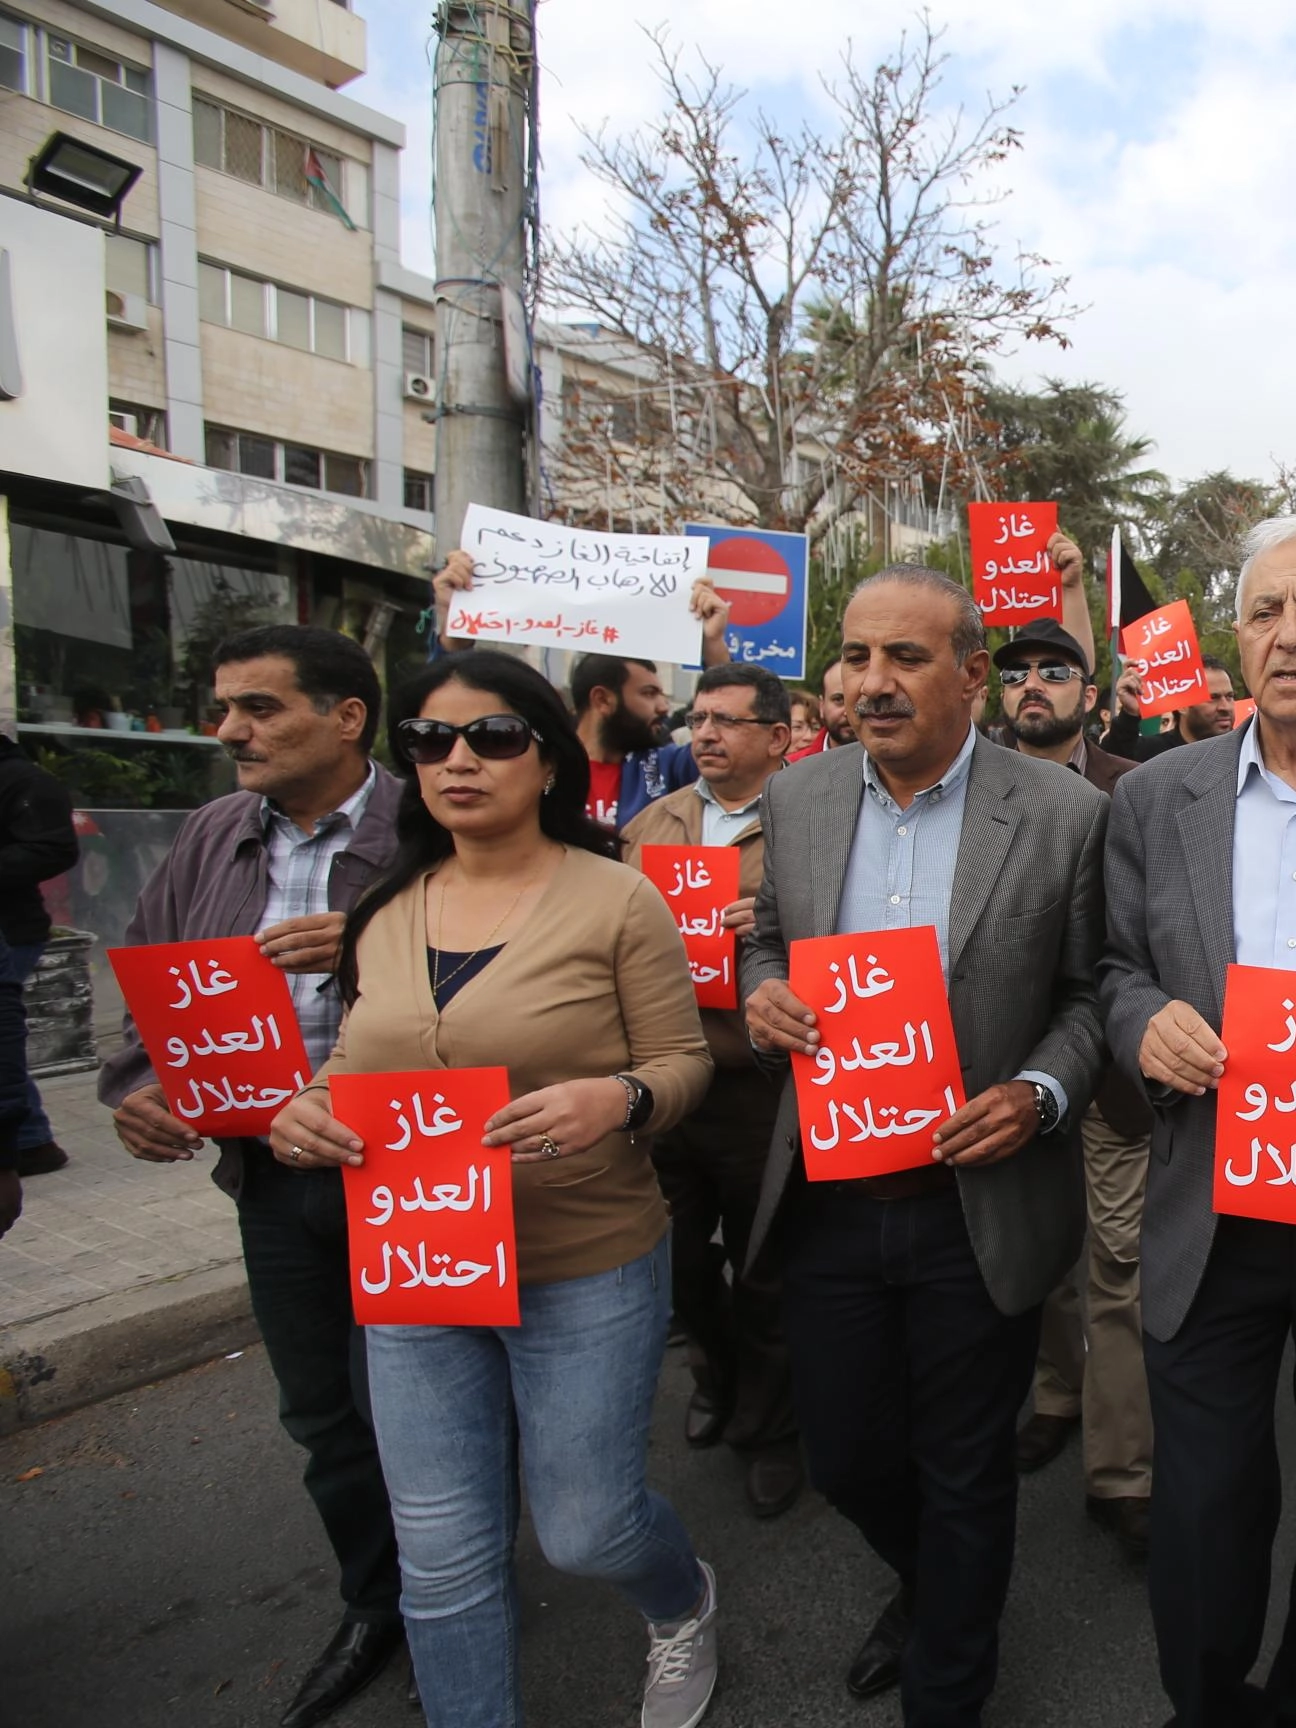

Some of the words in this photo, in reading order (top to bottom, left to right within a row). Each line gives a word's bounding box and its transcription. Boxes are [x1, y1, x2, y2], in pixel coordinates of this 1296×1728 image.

[993, 512, 1036, 545] غاز
[980, 550, 1051, 582] العدو
[978, 586, 1058, 614] احتلال
[742, 639, 796, 662] مخرج
[1140, 616, 1173, 646] غاز
[1137, 639, 1191, 677] العدو
[1140, 667, 1203, 705] احتلال
[666, 858, 713, 897] غاز
[678, 906, 726, 938] العد
[168, 958, 239, 1010] غاز
[823, 953, 896, 1014] غاز
[166, 1013, 283, 1069] العدو
[809, 1019, 935, 1087] العدو
[176, 1070, 305, 1119] احتلال
[384, 1091, 464, 1152] غاز
[809, 1085, 959, 1151] احتلال
[364, 1164, 491, 1227] العدو
[359, 1240, 507, 1296] احتلال
